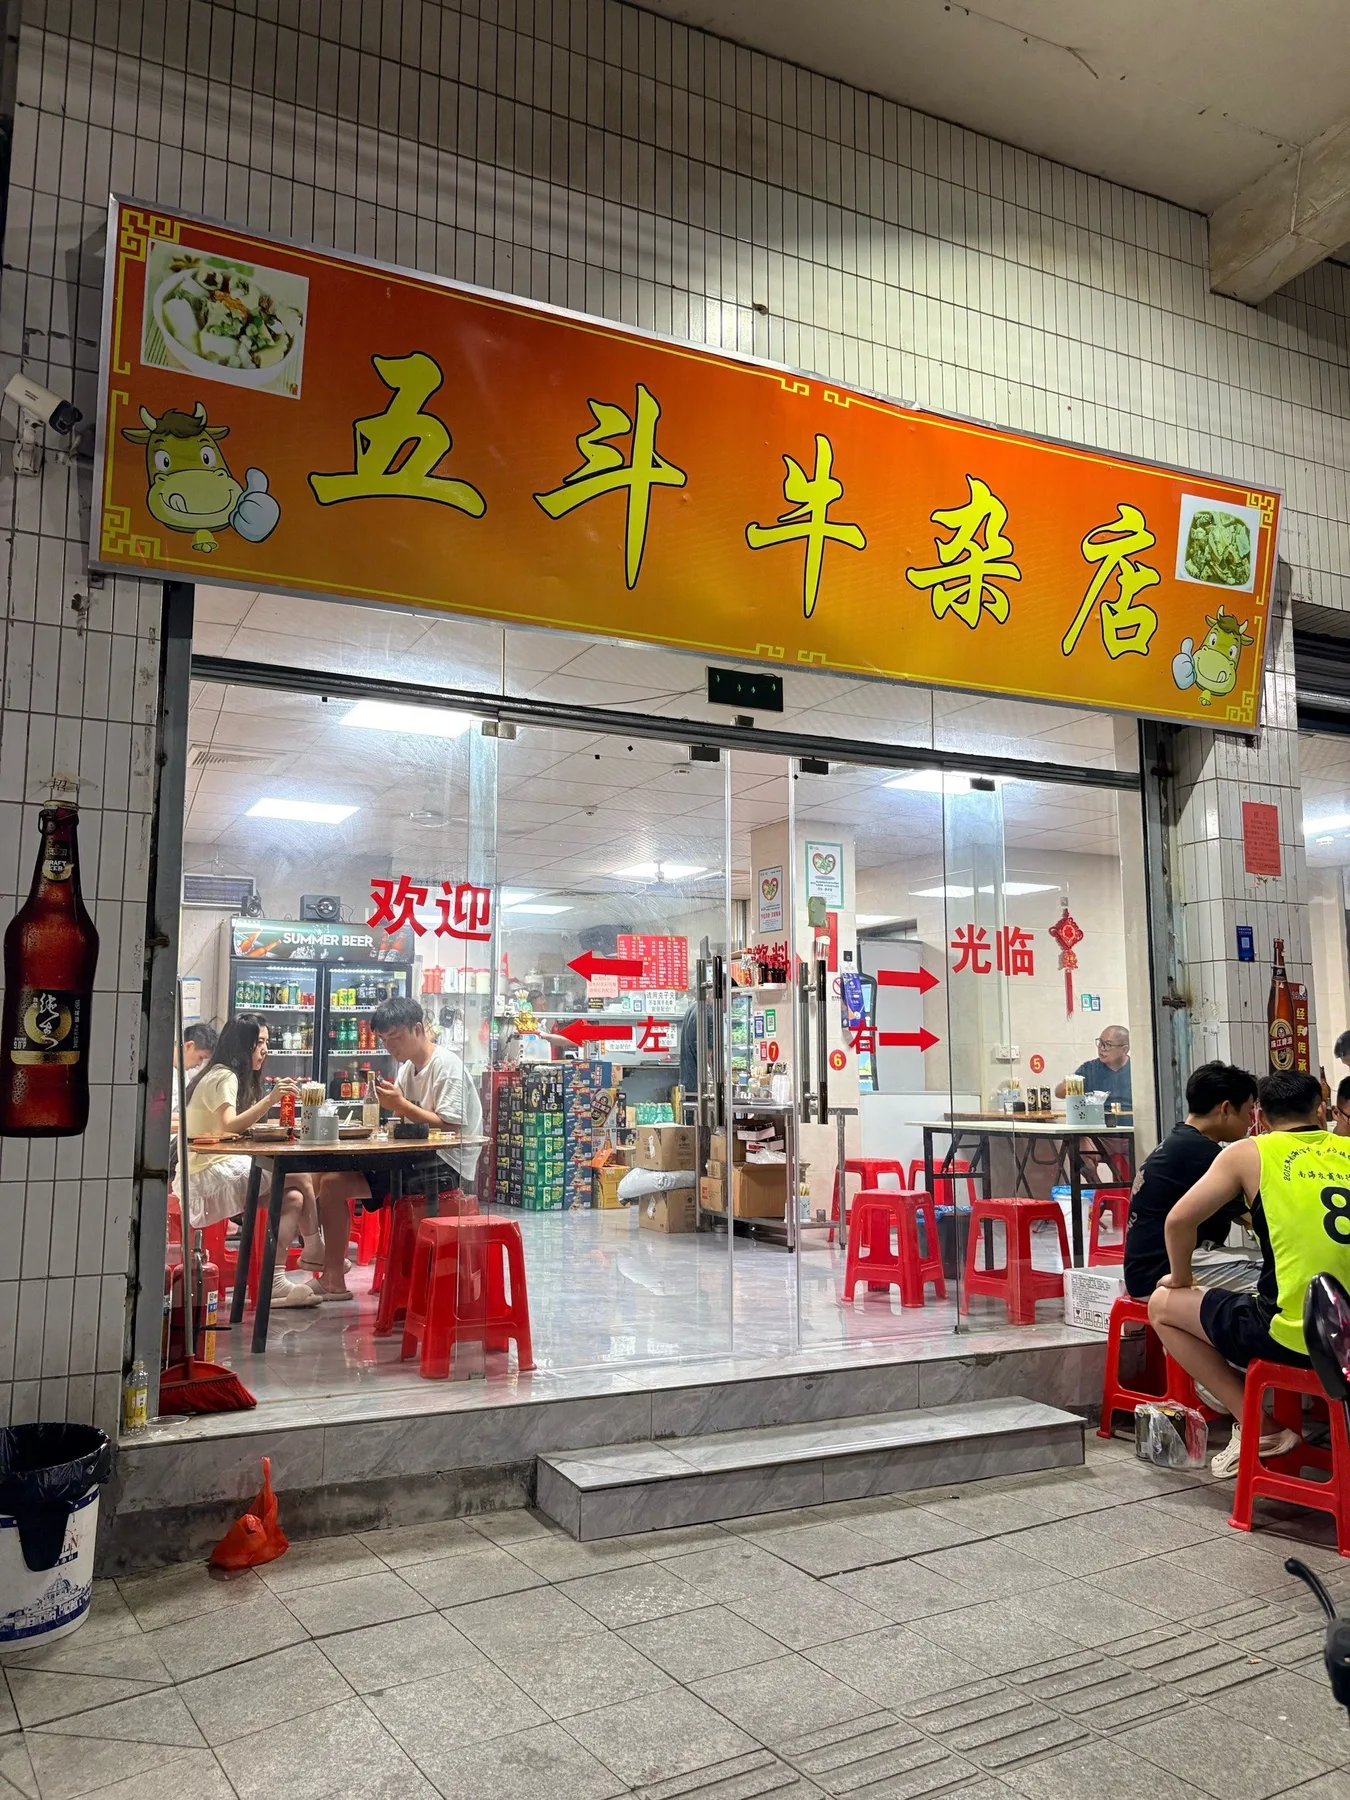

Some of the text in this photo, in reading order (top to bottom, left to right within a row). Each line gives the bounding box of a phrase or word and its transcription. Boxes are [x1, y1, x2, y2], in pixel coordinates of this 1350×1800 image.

[308, 352, 1160, 659] 五斗牛杂店
[367, 875, 491, 942] 欢迎
[283, 932, 374, 947] SUMMER BEER
[951, 924, 1034, 976] 光临
[637, 1015, 670, 1053] 左
[848, 1020, 878, 1054] 右
[771, 1045, 776, 1058] 7
[834, 1053, 842, 1067] 6
[1034, 1058, 1040, 1070] 5
[283, 1095, 292, 1126] 王老吉
